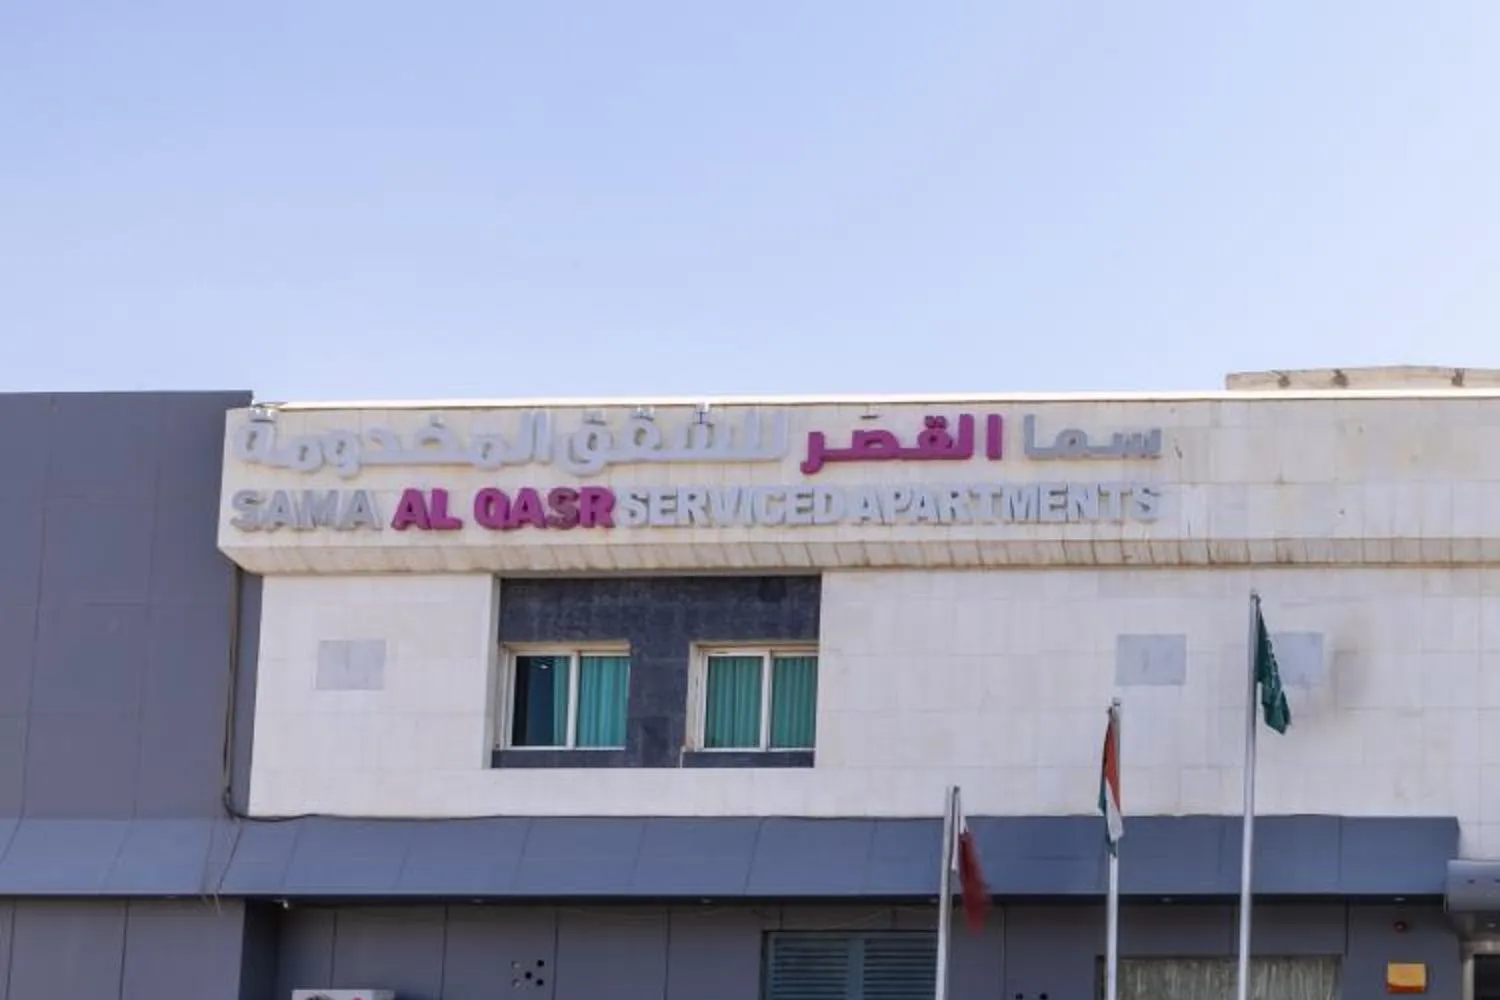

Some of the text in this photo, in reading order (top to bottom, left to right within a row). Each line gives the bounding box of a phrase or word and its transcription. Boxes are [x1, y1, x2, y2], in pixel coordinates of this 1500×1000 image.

[557, 402, 792, 478] للشقق
[800, 412, 1004, 475] القصر
[1022, 413, 1163, 460] سما
[229, 483, 1164, 532] SAMA AL QASR SERVICED APARTMENTS
